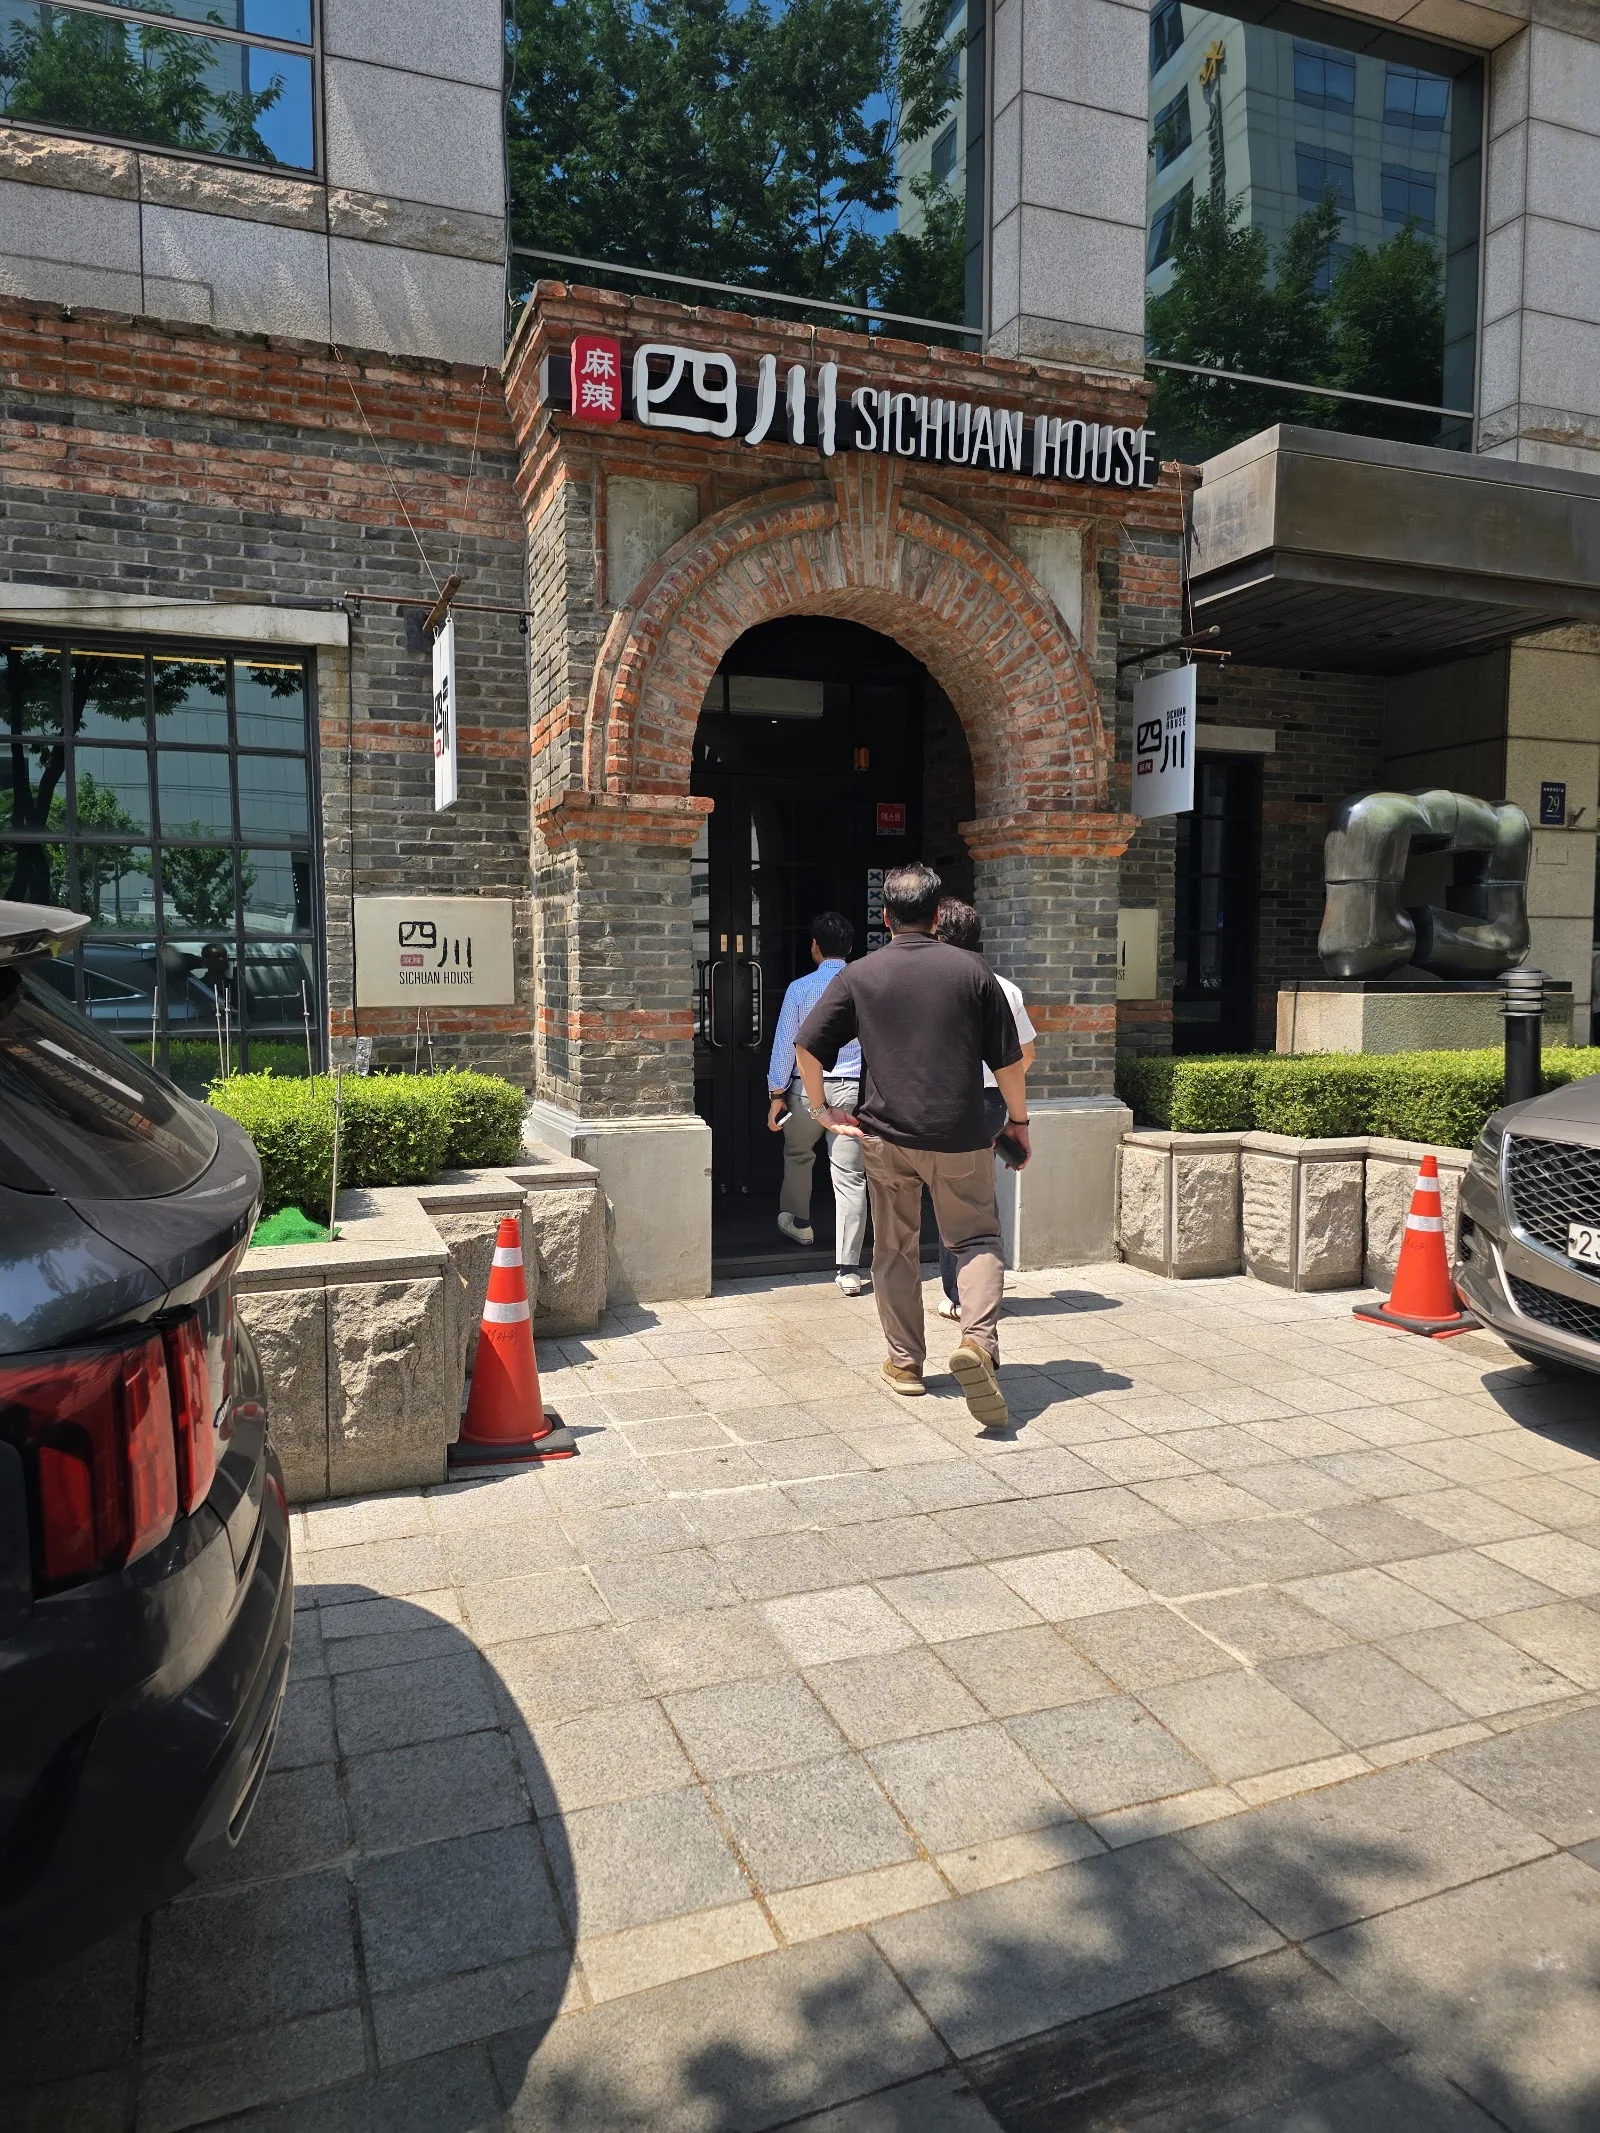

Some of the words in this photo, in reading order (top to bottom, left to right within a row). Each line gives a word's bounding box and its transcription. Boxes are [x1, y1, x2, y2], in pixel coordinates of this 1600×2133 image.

[580, 347, 617, 413] 麻辣
[633, 343, 839, 458] 四川
[852, 386, 1024, 472] SICHUAN
[1035, 414, 1157, 489] HOUSE
[1137, 718, 1186, 774] 四川
[1546, 795, 1560, 813] 29
[398, 920, 473, 968] 四川
[399, 971, 440, 985] SICHUAN
[443, 971, 475, 985] HOUSE
